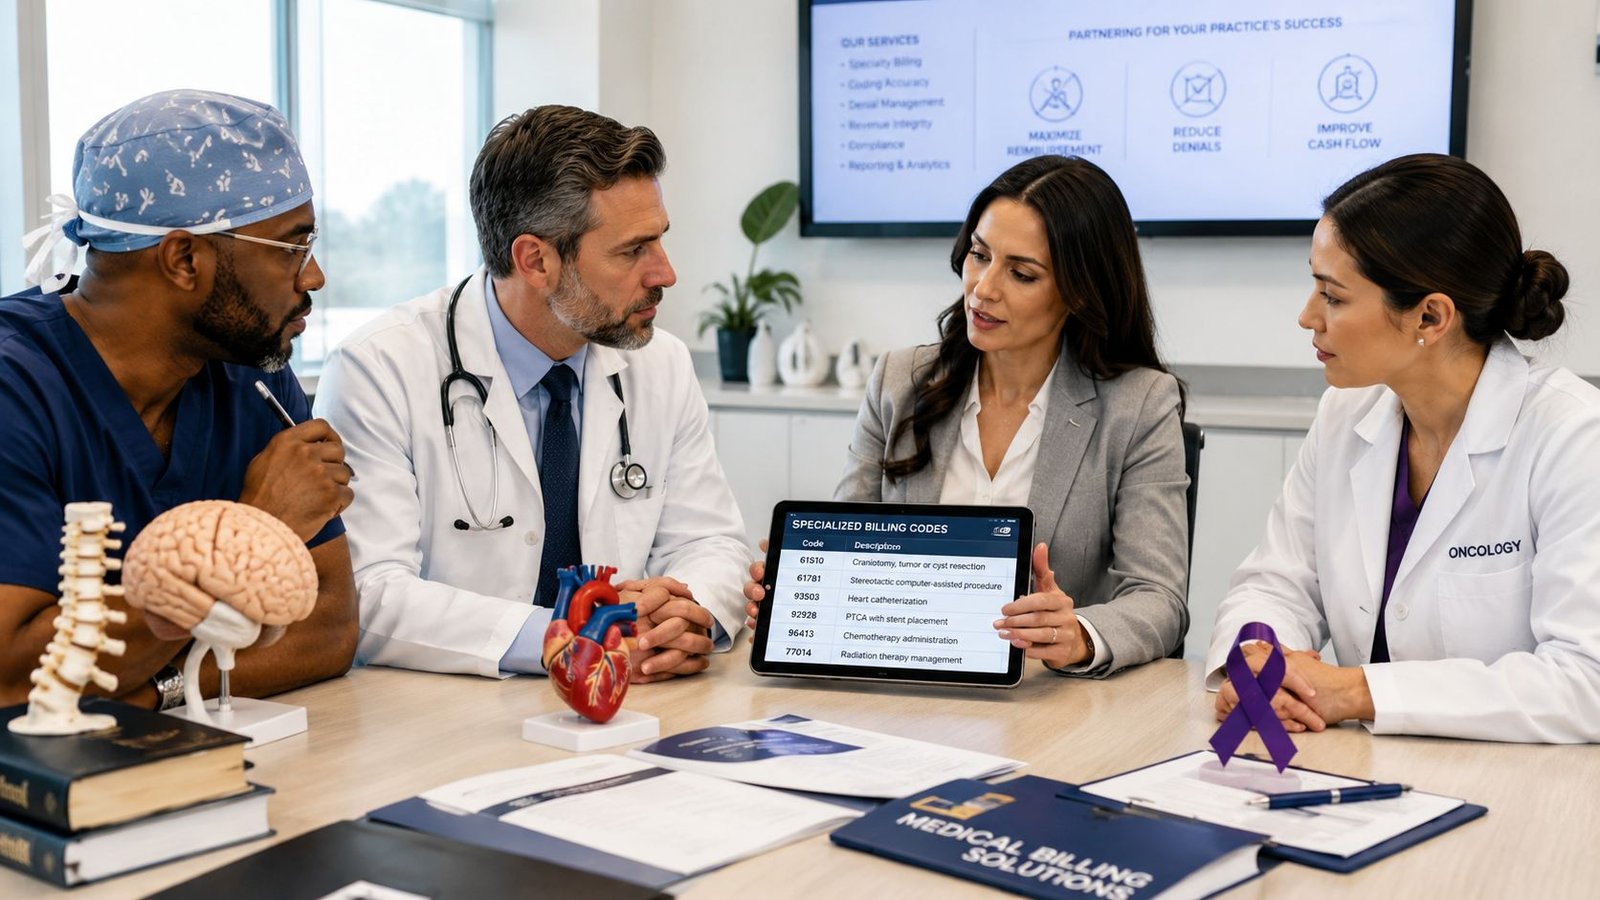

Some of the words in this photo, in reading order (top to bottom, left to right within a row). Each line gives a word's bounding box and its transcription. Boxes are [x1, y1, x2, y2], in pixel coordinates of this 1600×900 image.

[1068, 27, 1142, 40] PARTNERING
[1145, 25, 1170, 37] FOR
[1173, 23, 1206, 35] YOUR
[1210, 20, 1281, 33] PRACTICE'S
[1284, 17, 1342, 30] SUCCESS
[841, 37, 865, 48] OUR
[867, 35, 919, 47] SERVICES
[1173, 126, 1222, 137] REDUCE
[1318, 122, 1373, 134] IMPROVE
[1029, 130, 1082, 141] MAXIMIZE
[1172, 141, 1222, 153] DENIALS
[1308, 138, 1342, 150] CASH
[1345, 137, 1382, 149] FLOW
[792, 519, 862, 532] SPECIALIZED
[865, 521, 906, 533] BILLING
[909, 523, 948, 534] CODES
[802, 539, 824, 548] Code
[1449, 540, 1522, 558] ONCOLOGY
[852, 558, 897, 569] Craniotomy,
[899, 560, 921, 568] tumor
[932, 562, 948, 571] cyst
[950, 562, 986, 571] resection
[797, 574, 821, 582] 61781
[850, 576, 894, 586] Stereotactic
[895, 578, 962, 589] computer-assisted
[964, 581, 1003, 591] procedure
[848, 594, 869, 603] Heart
[870, 595, 928, 606] catheterization
[791, 610, 817, 619] 92928
[845, 613, 867, 622] PTCA
[869, 614, 885, 623] with
[886, 616, 906, 624] stent
[907, 616, 948, 626] placement
[788, 628, 814, 638] 96413
[843, 631, 901, 643] Chemotherapy
[902, 633, 958, 645] administration
[786, 647, 812, 656] 77014
[840, 650, 877, 660] Radiation
[879, 653, 909, 662] therapy
[910, 654, 963, 665] management
[896, 812, 1024, 856] MEDICAL
[1027, 846, 1154, 888] BILLING
[961, 847, 1136, 900] SOLUTIONS
